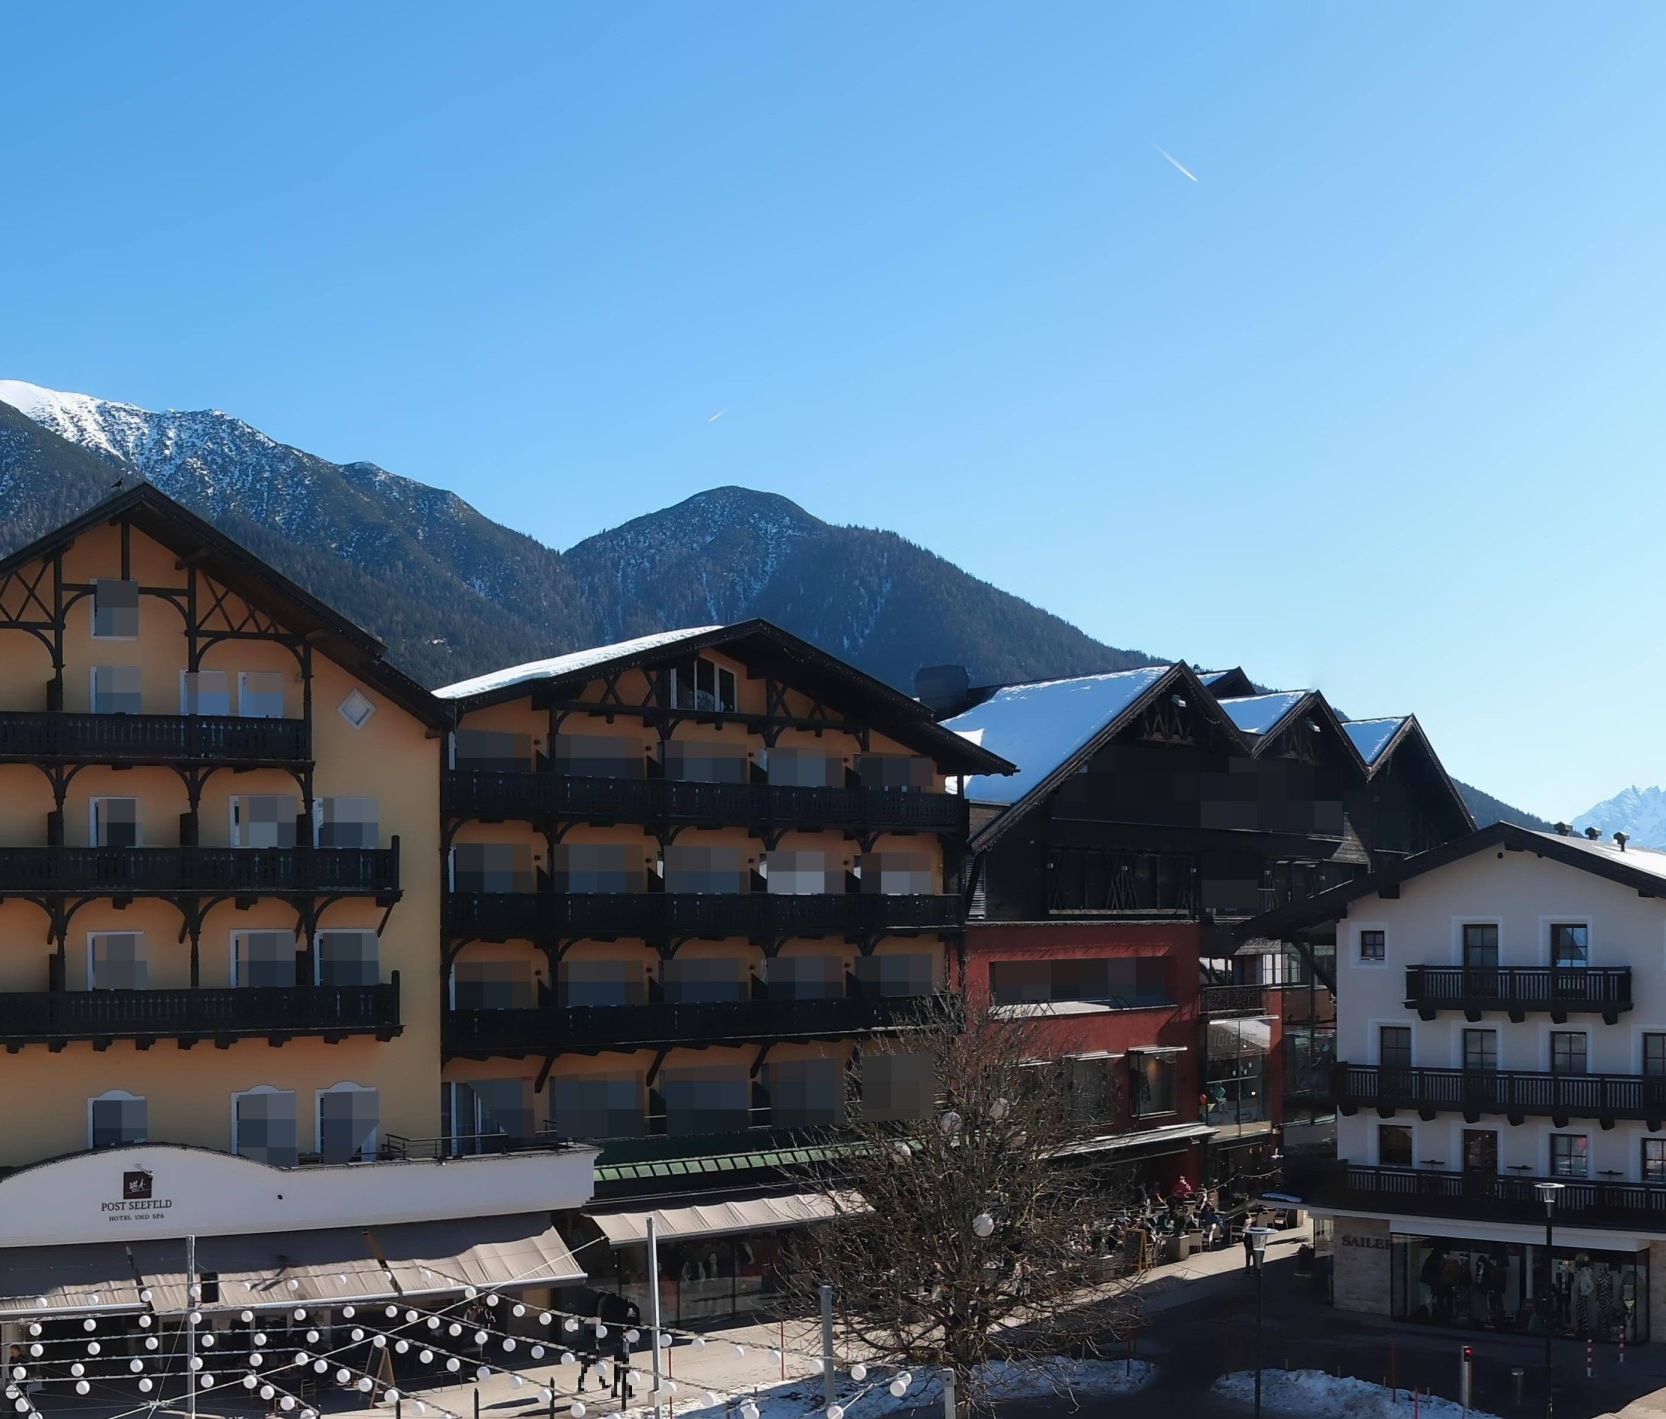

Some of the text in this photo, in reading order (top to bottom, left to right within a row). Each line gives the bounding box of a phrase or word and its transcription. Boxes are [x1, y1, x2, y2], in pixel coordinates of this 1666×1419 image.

[101, 1199, 172, 1212] POST SEEFELD
[109, 1214, 132, 1222] HOTEL
